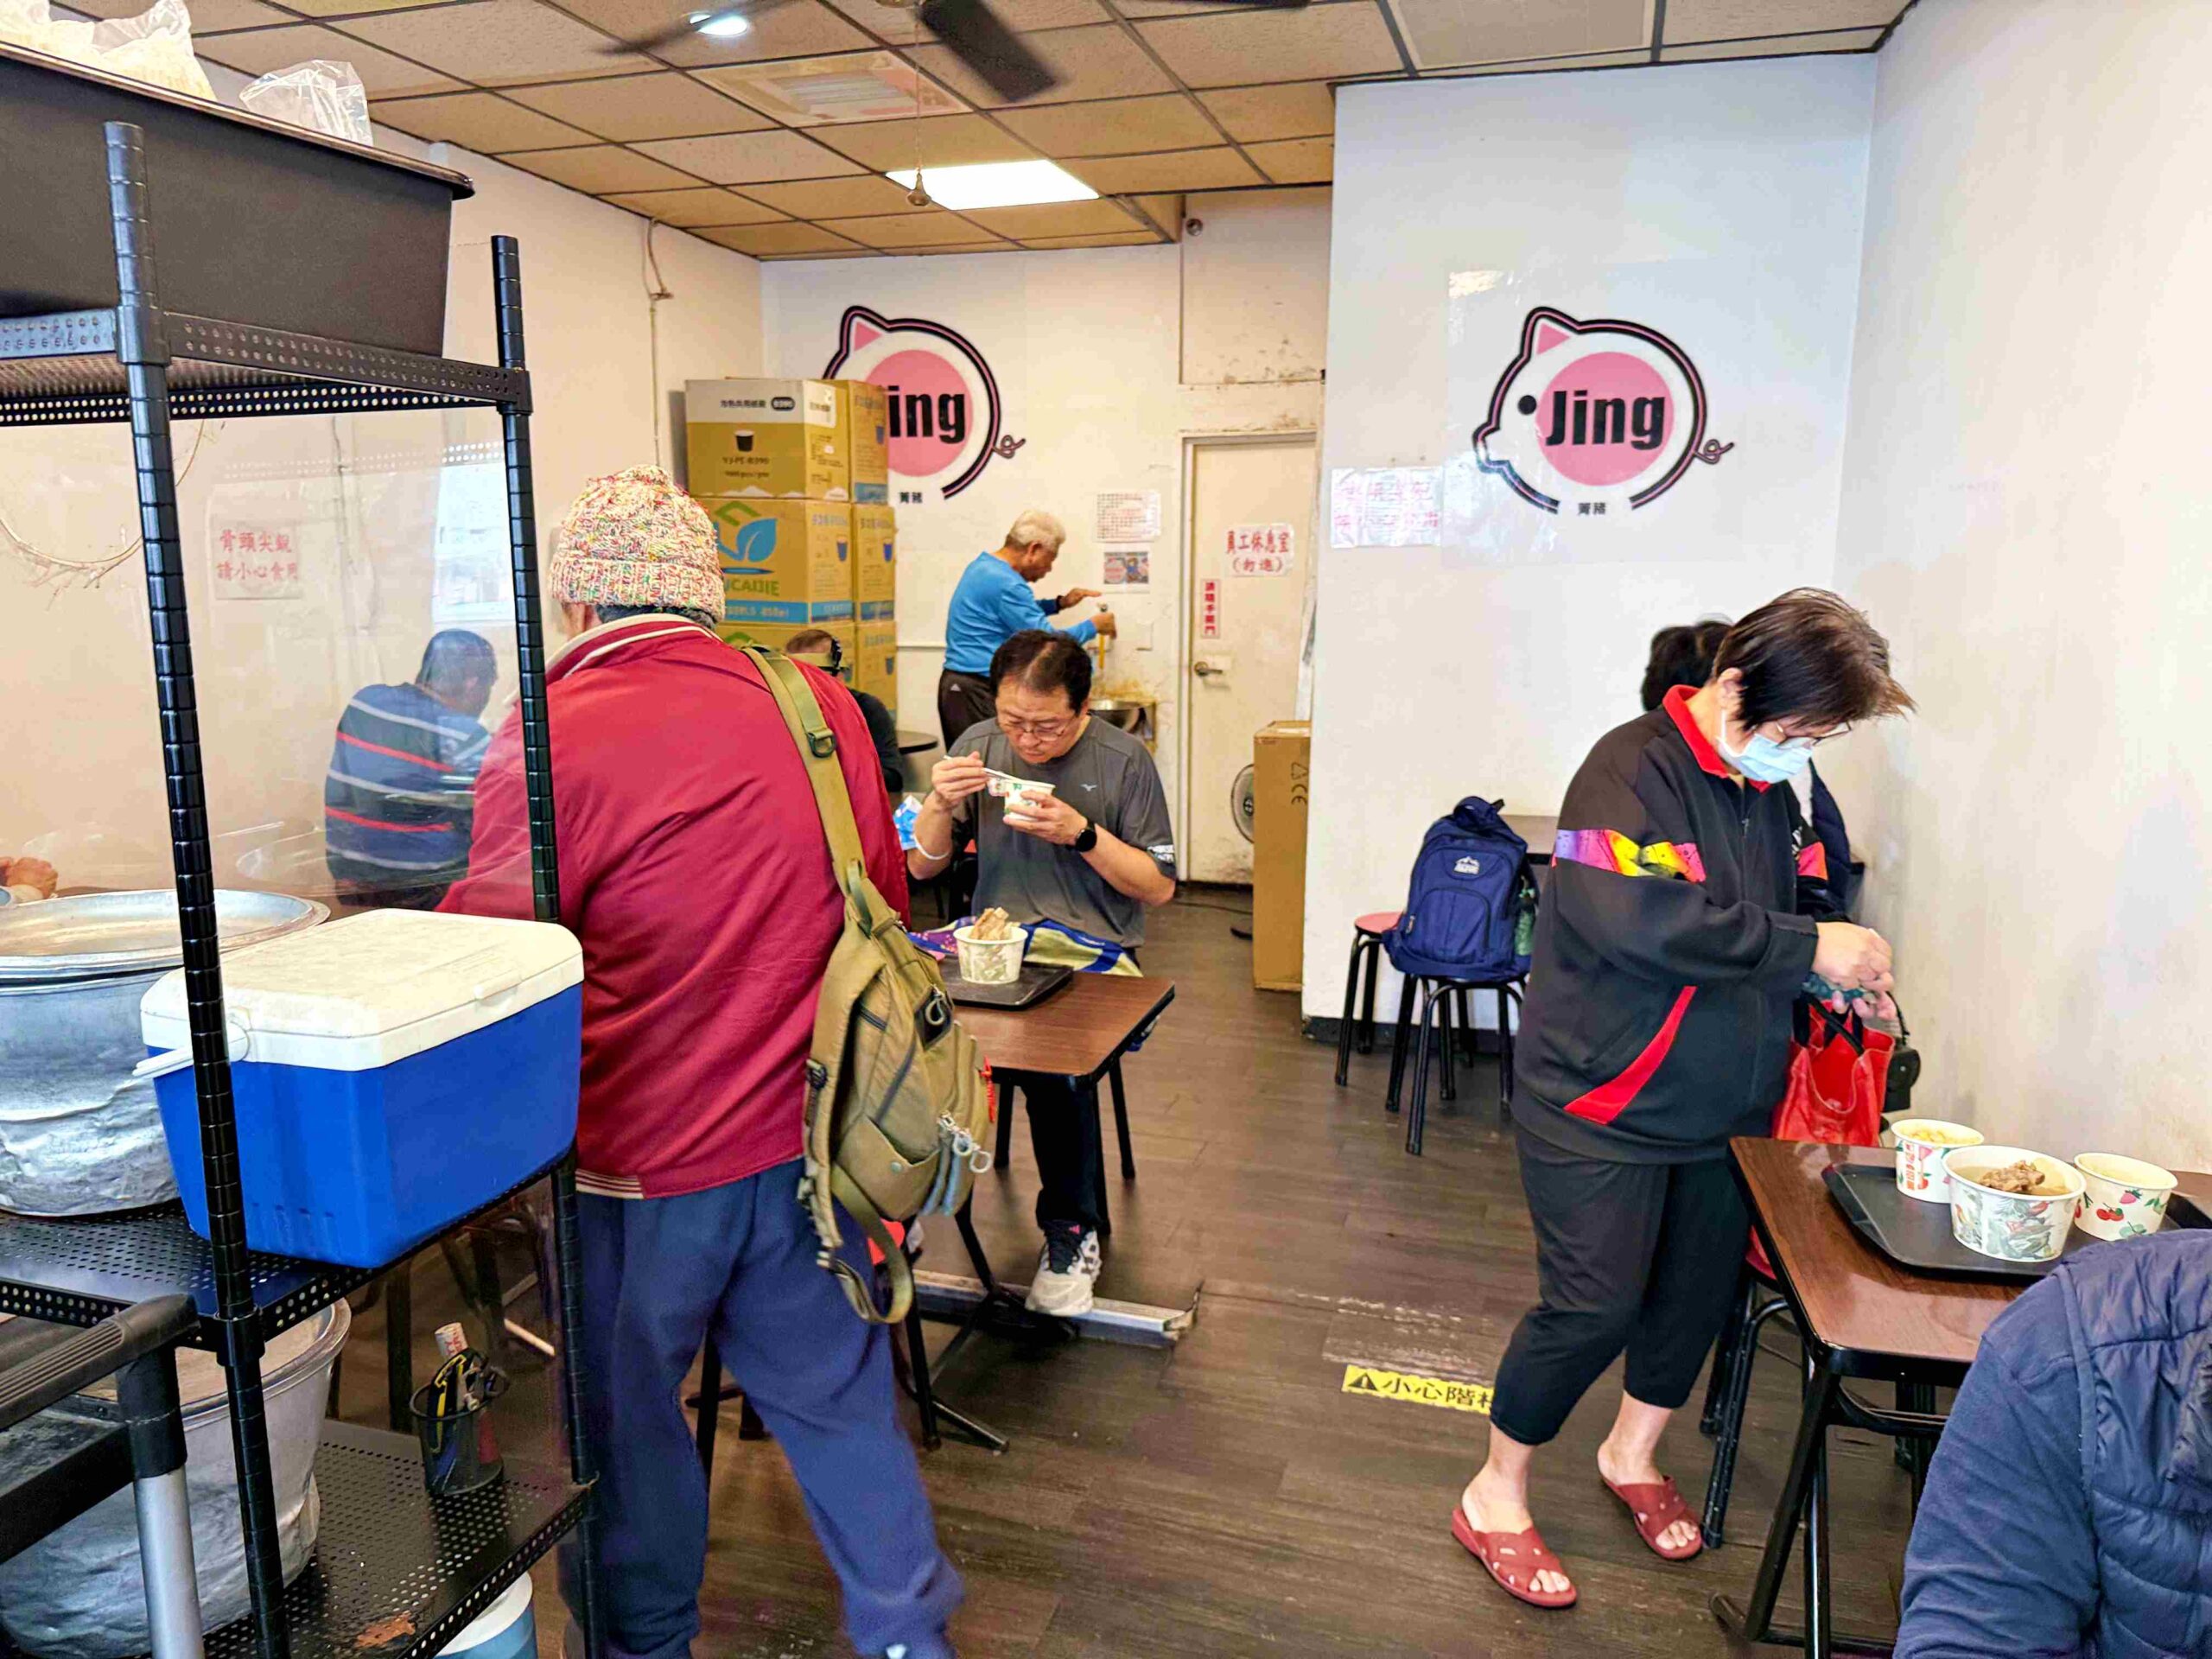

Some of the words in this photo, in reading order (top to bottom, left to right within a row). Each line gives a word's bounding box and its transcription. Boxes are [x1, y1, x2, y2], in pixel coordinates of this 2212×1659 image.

[888, 385, 965, 444] ing
[1545, 390, 1666, 450] Jing
[219, 529, 292, 553] 骨頭尖銳
[1226, 530, 1291, 554] 員工休息室
[216, 561, 298, 581] 請小心食用
